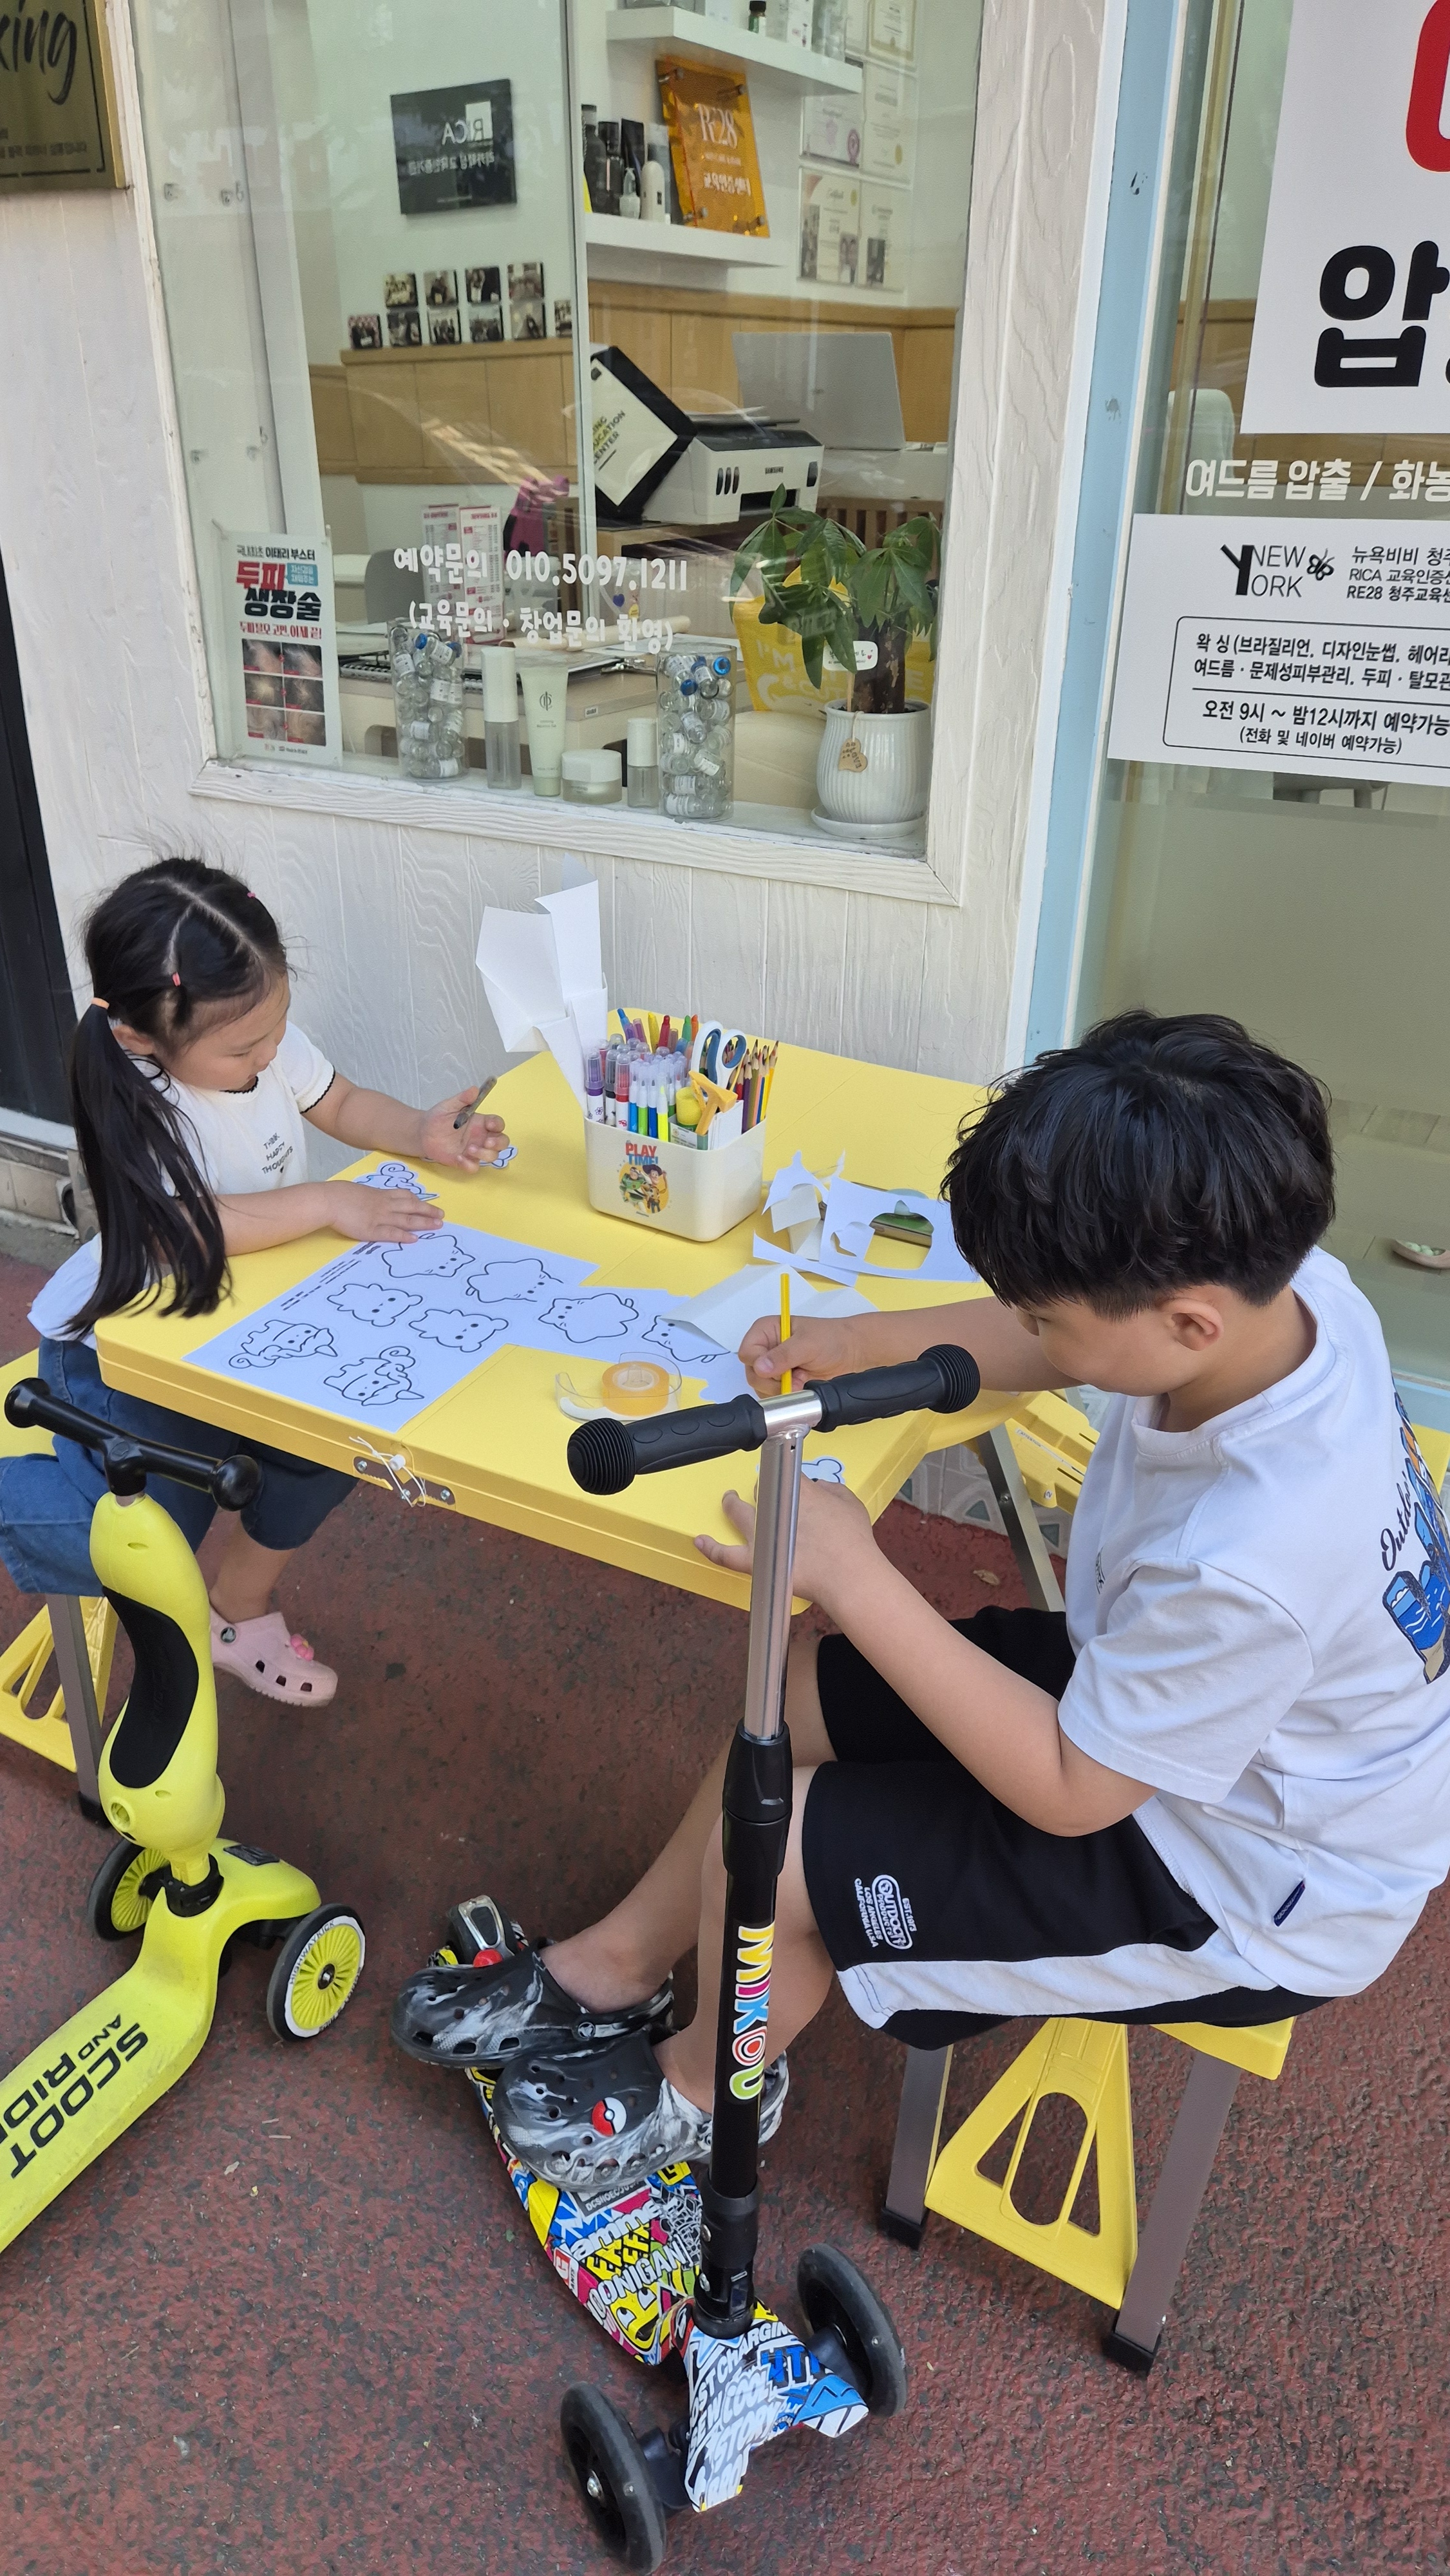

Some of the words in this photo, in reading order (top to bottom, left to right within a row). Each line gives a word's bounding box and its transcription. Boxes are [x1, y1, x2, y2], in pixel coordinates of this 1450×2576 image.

[1185, 459, 1279, 500] 여드름
[1285, 458, 1351, 501] 압출
[291, 548, 315, 561] 부스터
[393, 542, 487, 584] 예약문의
[505, 549, 687, 591] 010.5097.1211
[1252, 544, 1306, 568] NEW
[1351, 545, 1419, 565] 뉴욕비비
[236, 560, 286, 591] 두피
[1349, 568, 1382, 582] RICA
[1346, 585, 1384, 600] RE28
[409, 599, 493, 638] (교육문의
[520, 607, 606, 648] 창업문의
[617, 614, 673, 654] 환영)
[1194, 658, 1235, 677] 여드름
[1361, 668, 1392, 688] 두피
[1202, 699, 1234, 720] 오전
[1239, 702, 1265, 723] 9시
[1293, 705, 1378, 730] 밤12시까지
[1384, 712, 1450, 735] 예약가능
[1239, 726, 1271, 744] (전화
[1277, 729, 1290, 746] 및
[1295, 731, 1335, 749] 네이버
[1342, 734, 1402, 755] 예약가능)
[266, 1141, 285, 1161] HAPPY
[625, 1142, 657, 1157] PLAY
[628, 1153, 659, 1166] TIME!
[854, 1878, 872, 1929] CALIFORNIA
[864, 1886, 874, 1904] LOS
[867, 1905, 883, 1940] ANGELES
[876, 1893, 894, 1938] PRODUCTS
[289, 1920, 335, 1985] HIGHWAYKICK
[730, 1921, 775, 2100] MIKOU
[78, 2013, 122, 2060] AND
[10, 2022, 149, 2179] SCOOT
